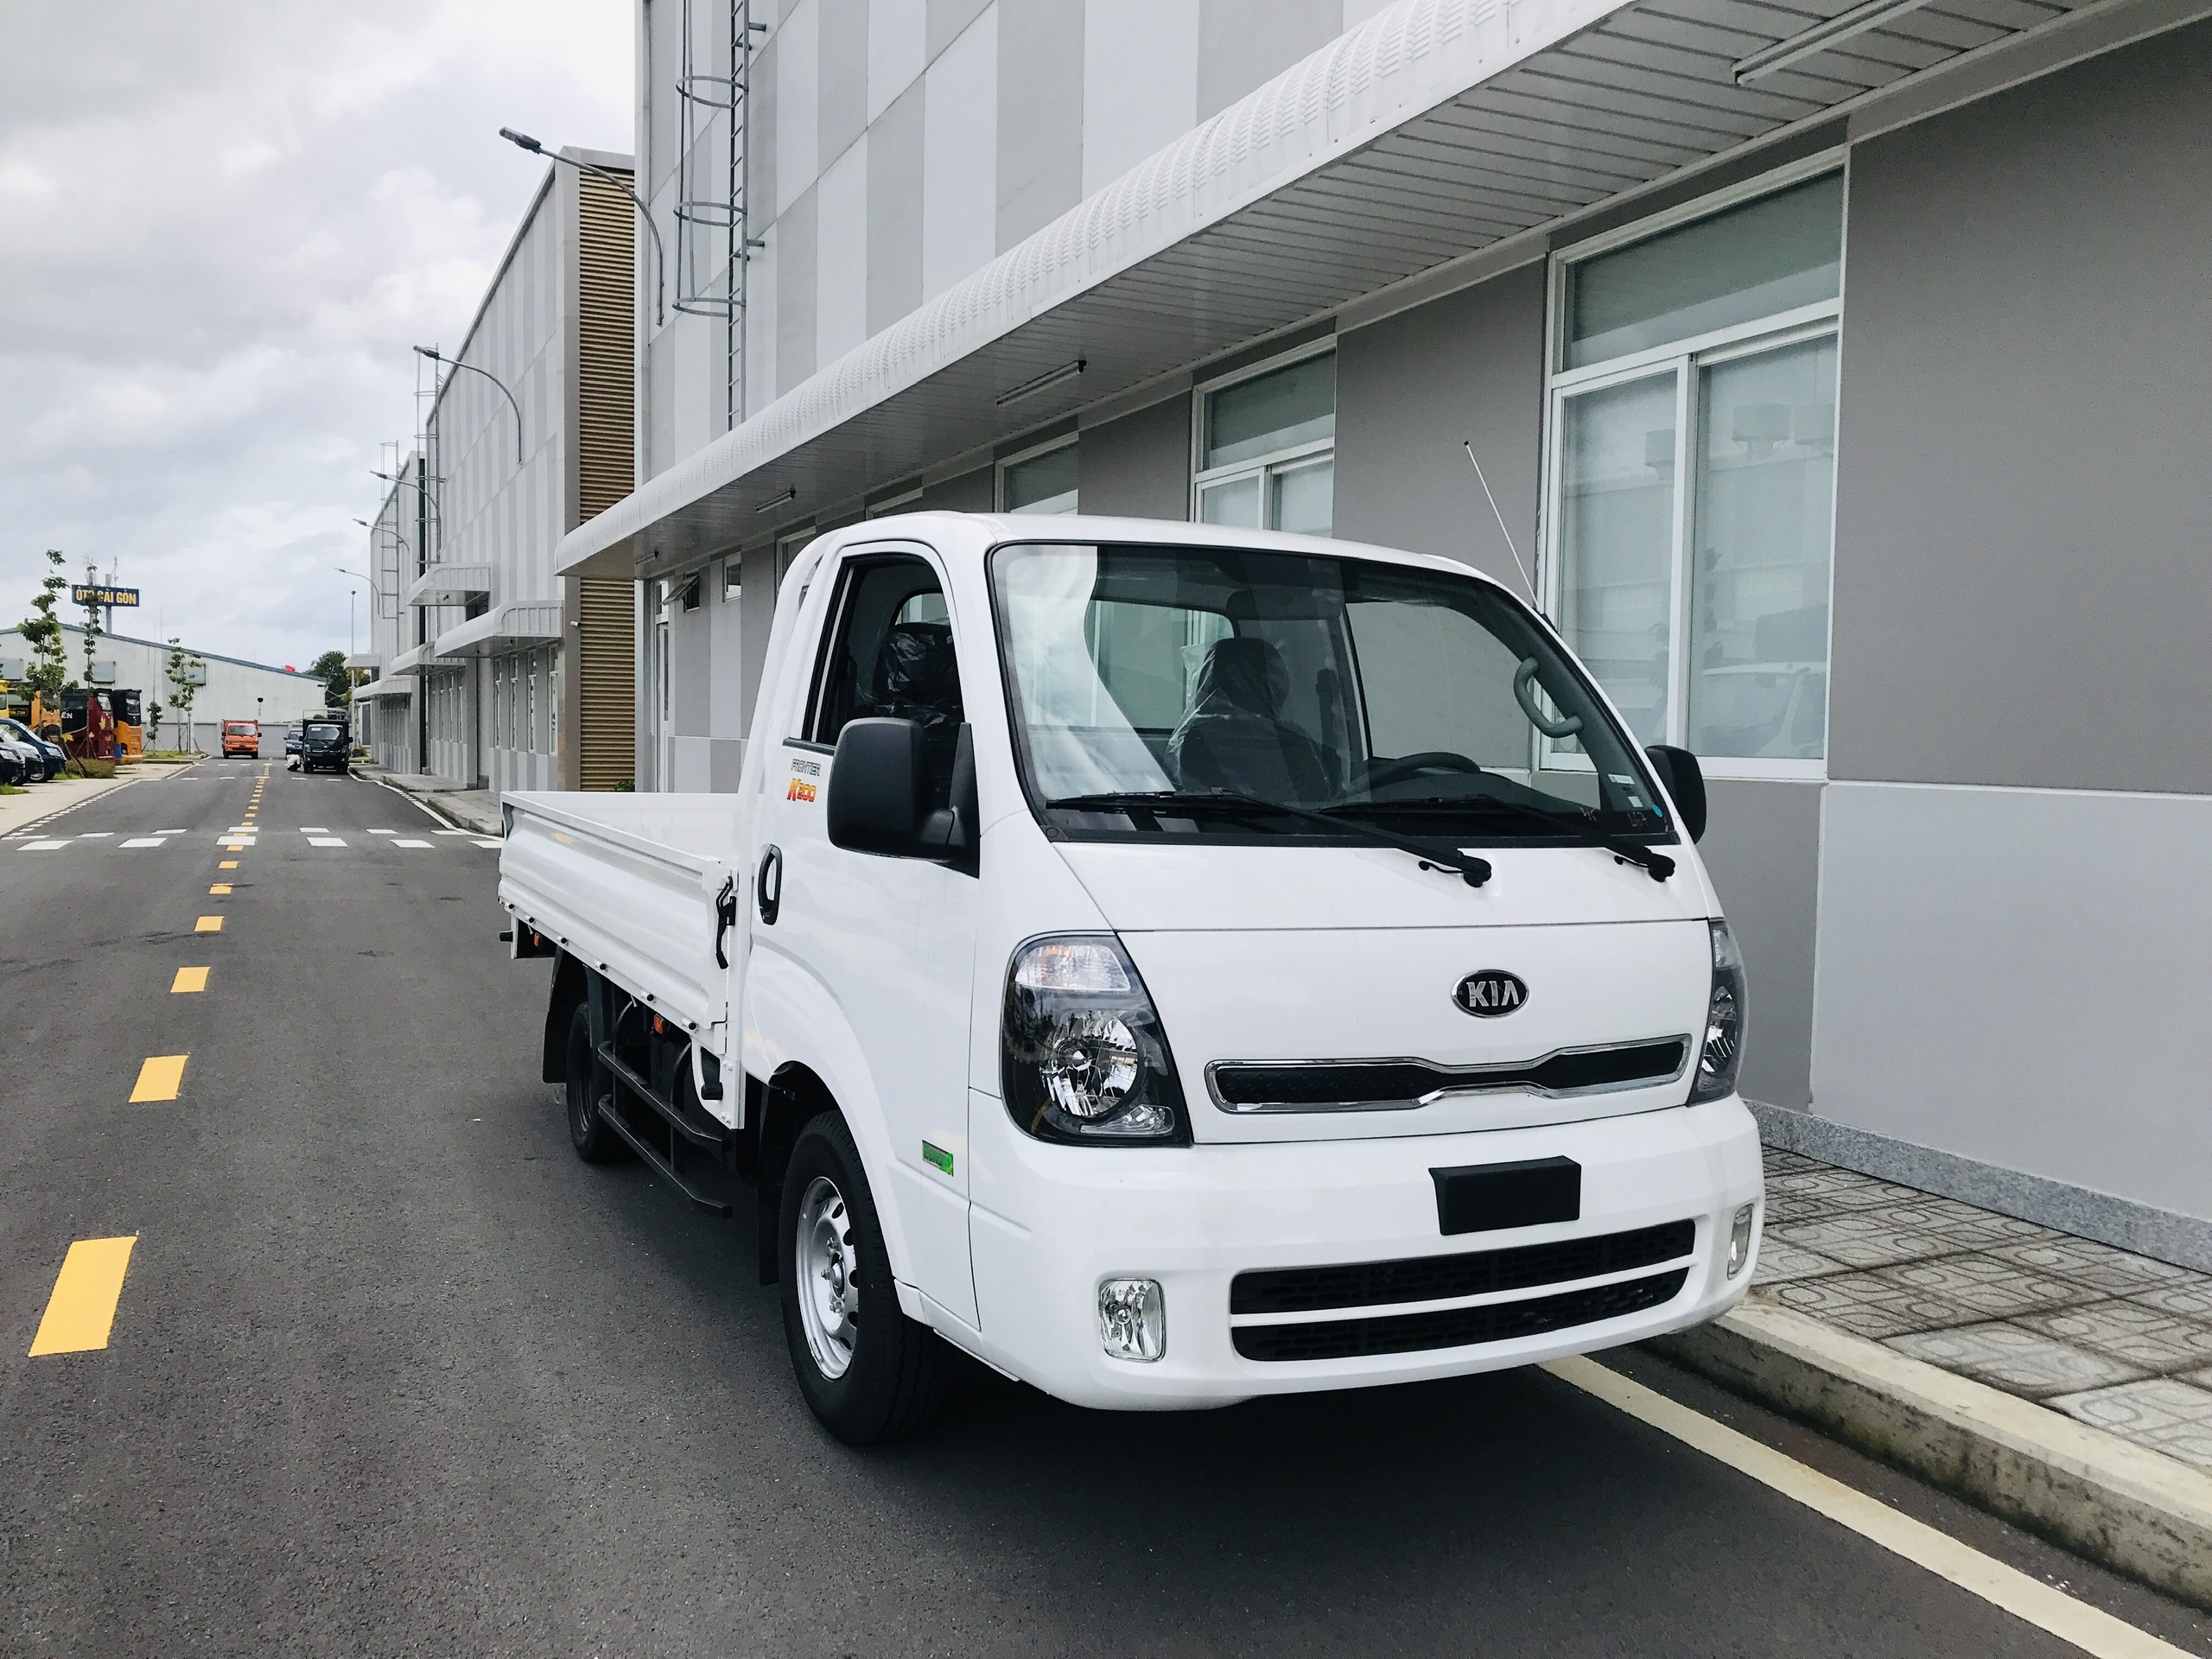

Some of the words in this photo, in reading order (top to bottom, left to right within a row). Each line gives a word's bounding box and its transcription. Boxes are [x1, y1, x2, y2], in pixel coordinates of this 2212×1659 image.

[791, 759, 822, 777] FRONTIER
[786, 778, 817, 803] K200
[1465, 980, 1520, 1007] KIA
